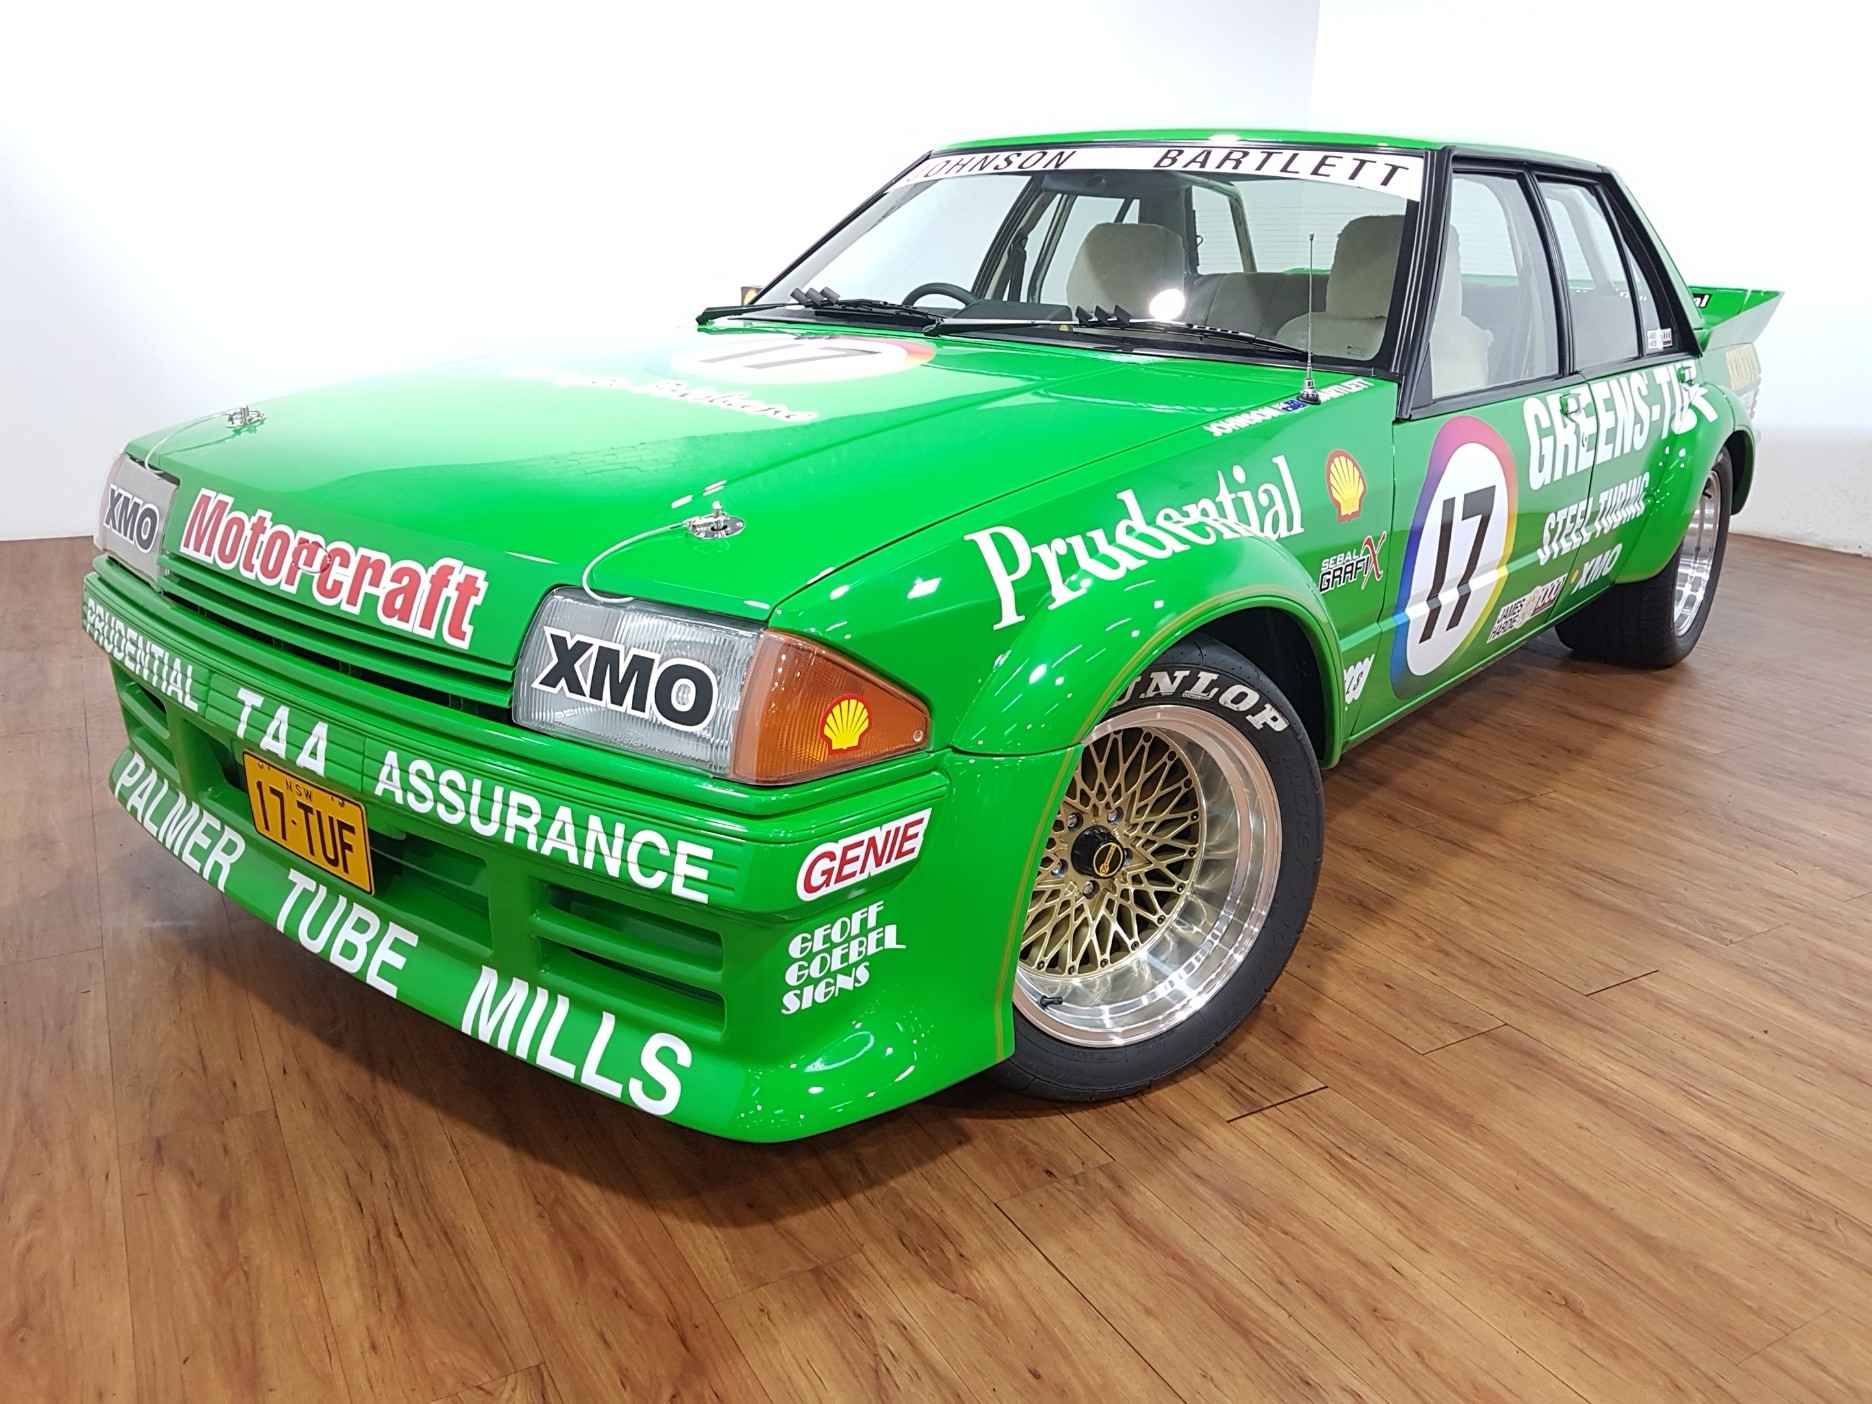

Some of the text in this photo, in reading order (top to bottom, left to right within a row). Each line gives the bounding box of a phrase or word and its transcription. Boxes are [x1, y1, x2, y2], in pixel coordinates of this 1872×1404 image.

[1154, 149, 1410, 187] BARTLETT
[698, 343, 883, 370] 17
[1203, 377, 1375, 437] JOHNSON ARTLETT
[103, 485, 160, 553] XMO
[964, 455, 1304, 630] Prudential
[1536, 471, 1650, 567] STEEL TUBING
[179, 487, 490, 650] Motorcraft
[1319, 530, 1387, 594] GRAFIX
[1418, 485, 1498, 645] 17
[1569, 542, 1623, 596] XMO
[532, 626, 721, 733] XMO
[1110, 670, 1291, 733] UNLOP
[86, 597, 715, 904] PRUDENTIAL TAA ASSURANCE
[284, 777, 314, 803] NSW
[801, 816, 925, 896] GENIE
[112, 752, 693, 1117] PALMER TUBE MILLS
[784, 923, 907, 987] GOEBEL
[788, 899, 885, 960] GEOFF
[780, 961, 871, 1016] SIGNS
